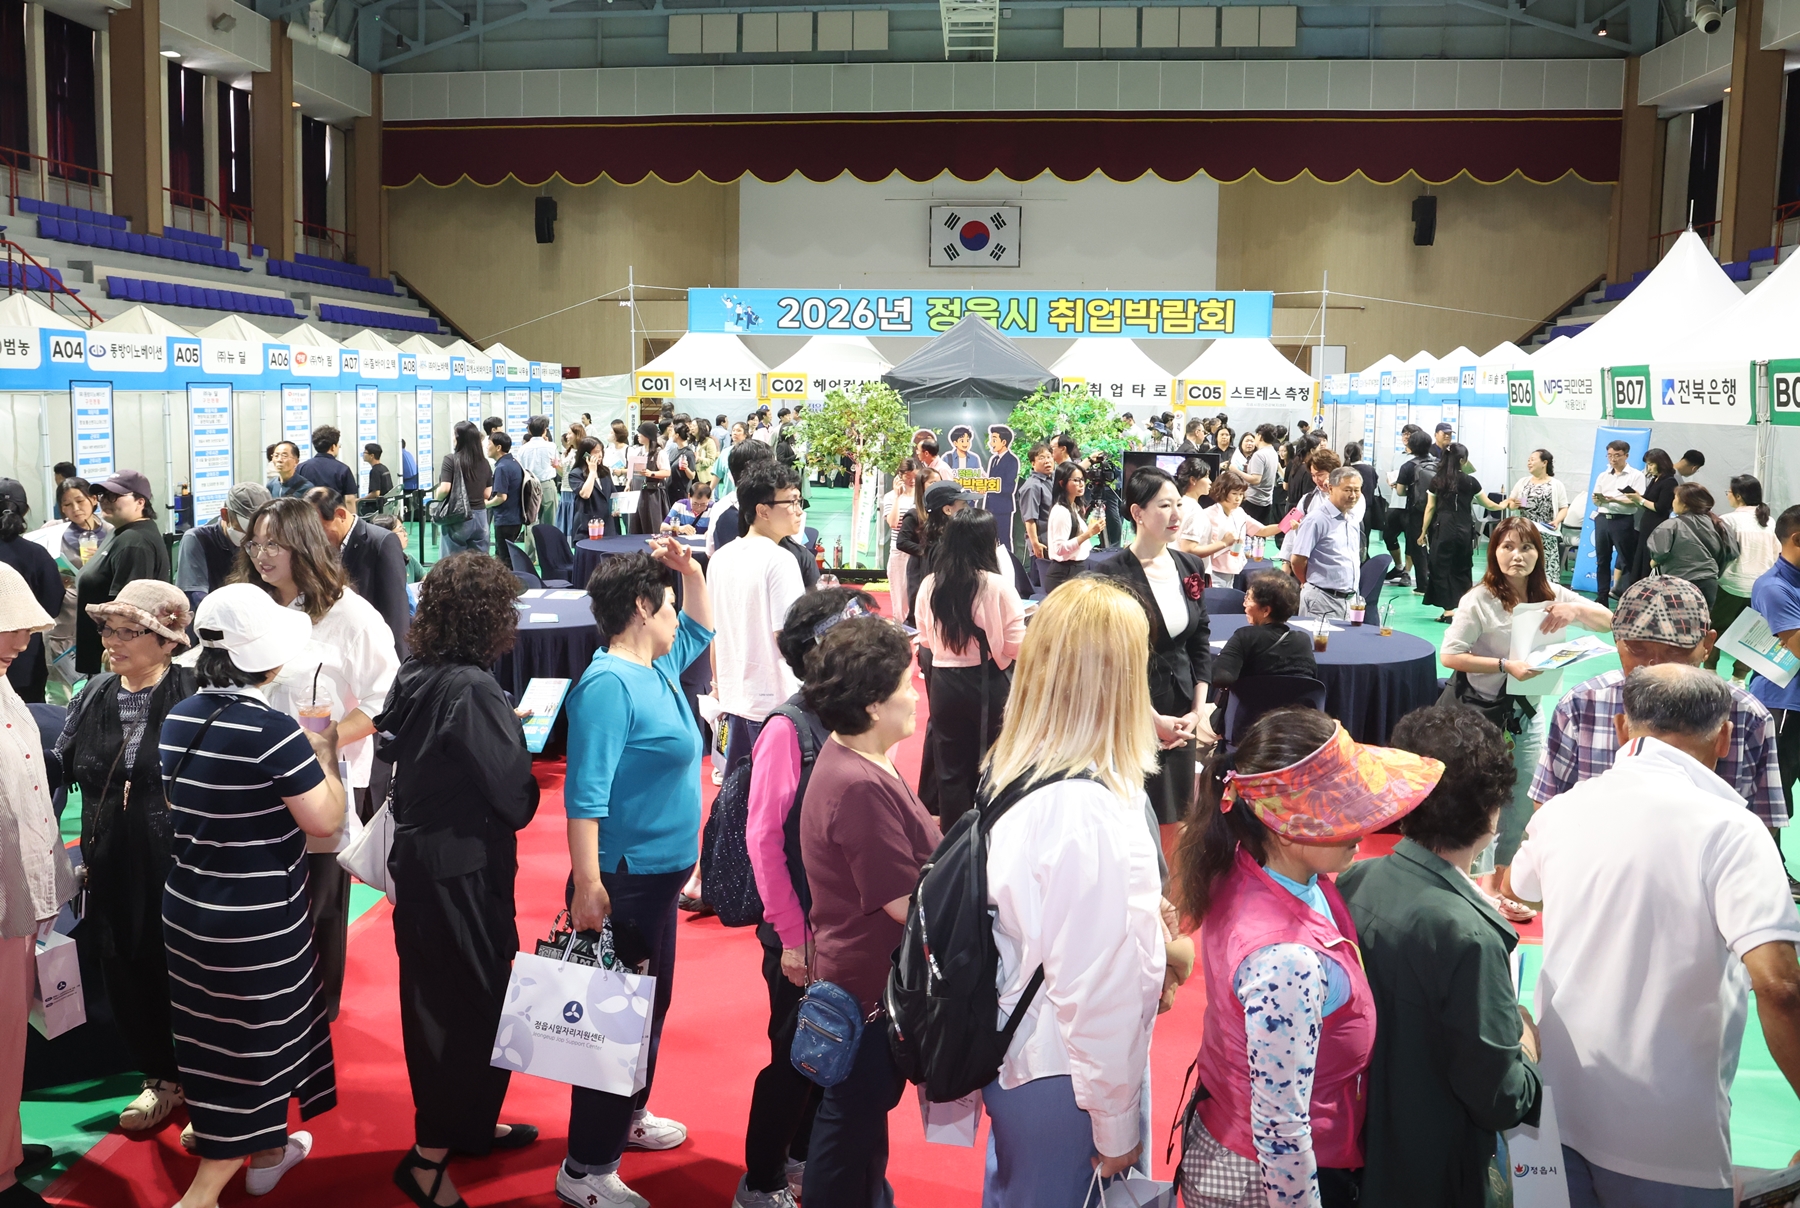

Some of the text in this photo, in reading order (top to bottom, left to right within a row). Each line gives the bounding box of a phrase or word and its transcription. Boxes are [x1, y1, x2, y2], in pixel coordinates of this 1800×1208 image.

[777, 297, 1236, 333] 2026년 정읍시 취업박람회
[52, 341, 83, 358] A04
[110, 344, 162, 360] 동방이노베이션
[176, 347, 199, 363] A05
[270, 353, 289, 366] A06
[344, 357, 358, 370] A07
[403, 360, 416, 372] A08
[454, 363, 464, 374] A09
[642, 377, 670, 391] C01
[679, 377, 752, 392] 이력서사진
[772, 379, 804, 392] C02
[1419, 375, 1428, 387] A15
[1463, 373, 1474, 386] A16
[1543, 379, 1592, 394] NPS 국민연금
[1189, 386, 1222, 400] C05
[1230, 387, 1310, 401] 스트레스 측정
[1511, 383, 1532, 404] B06
[1616, 380, 1644, 405] B07
[1678, 378, 1736, 406] 전북은행
[534, 1021, 605, 1043] 정읍시일자리지원센터
[566, 1039, 585, 1048] Support
[586, 1043, 603, 1051] Center
[1531, 1166, 1557, 1175] 정읍시
